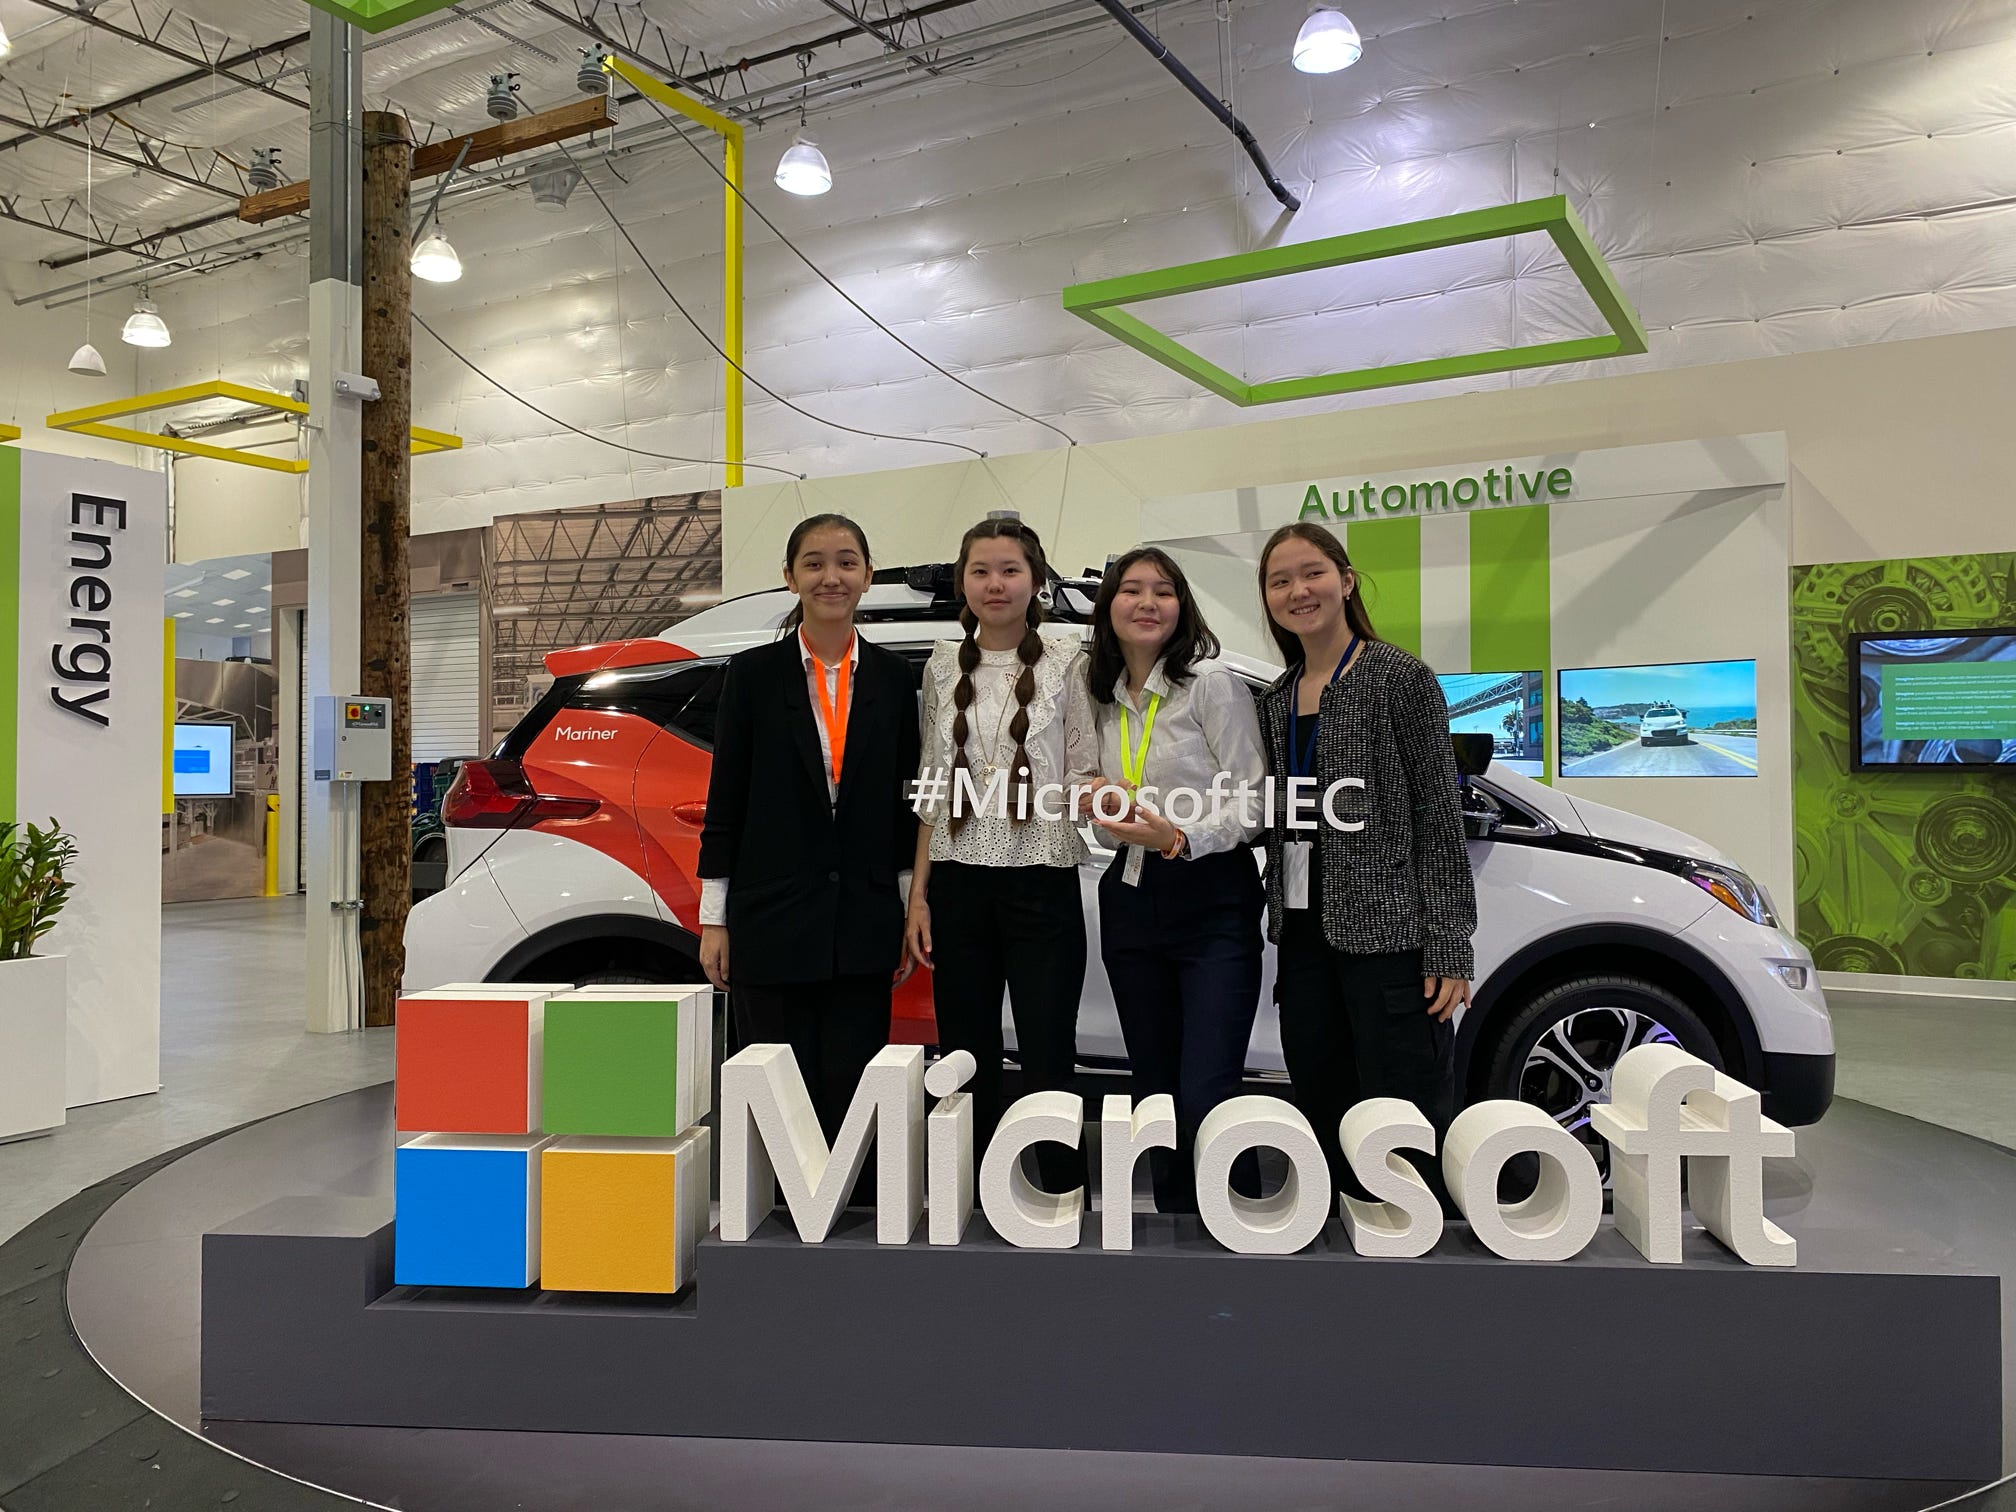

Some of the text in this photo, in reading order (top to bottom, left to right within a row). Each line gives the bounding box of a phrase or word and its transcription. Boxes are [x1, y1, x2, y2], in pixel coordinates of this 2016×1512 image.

[1298, 465, 1573, 520] Automotive
[51, 492, 127, 727] Energy
[555, 726, 618, 741] Mariner
[908, 766, 1365, 831] #MicrosoftIEC
[719, 1042, 1797, 1267] Microsoft
